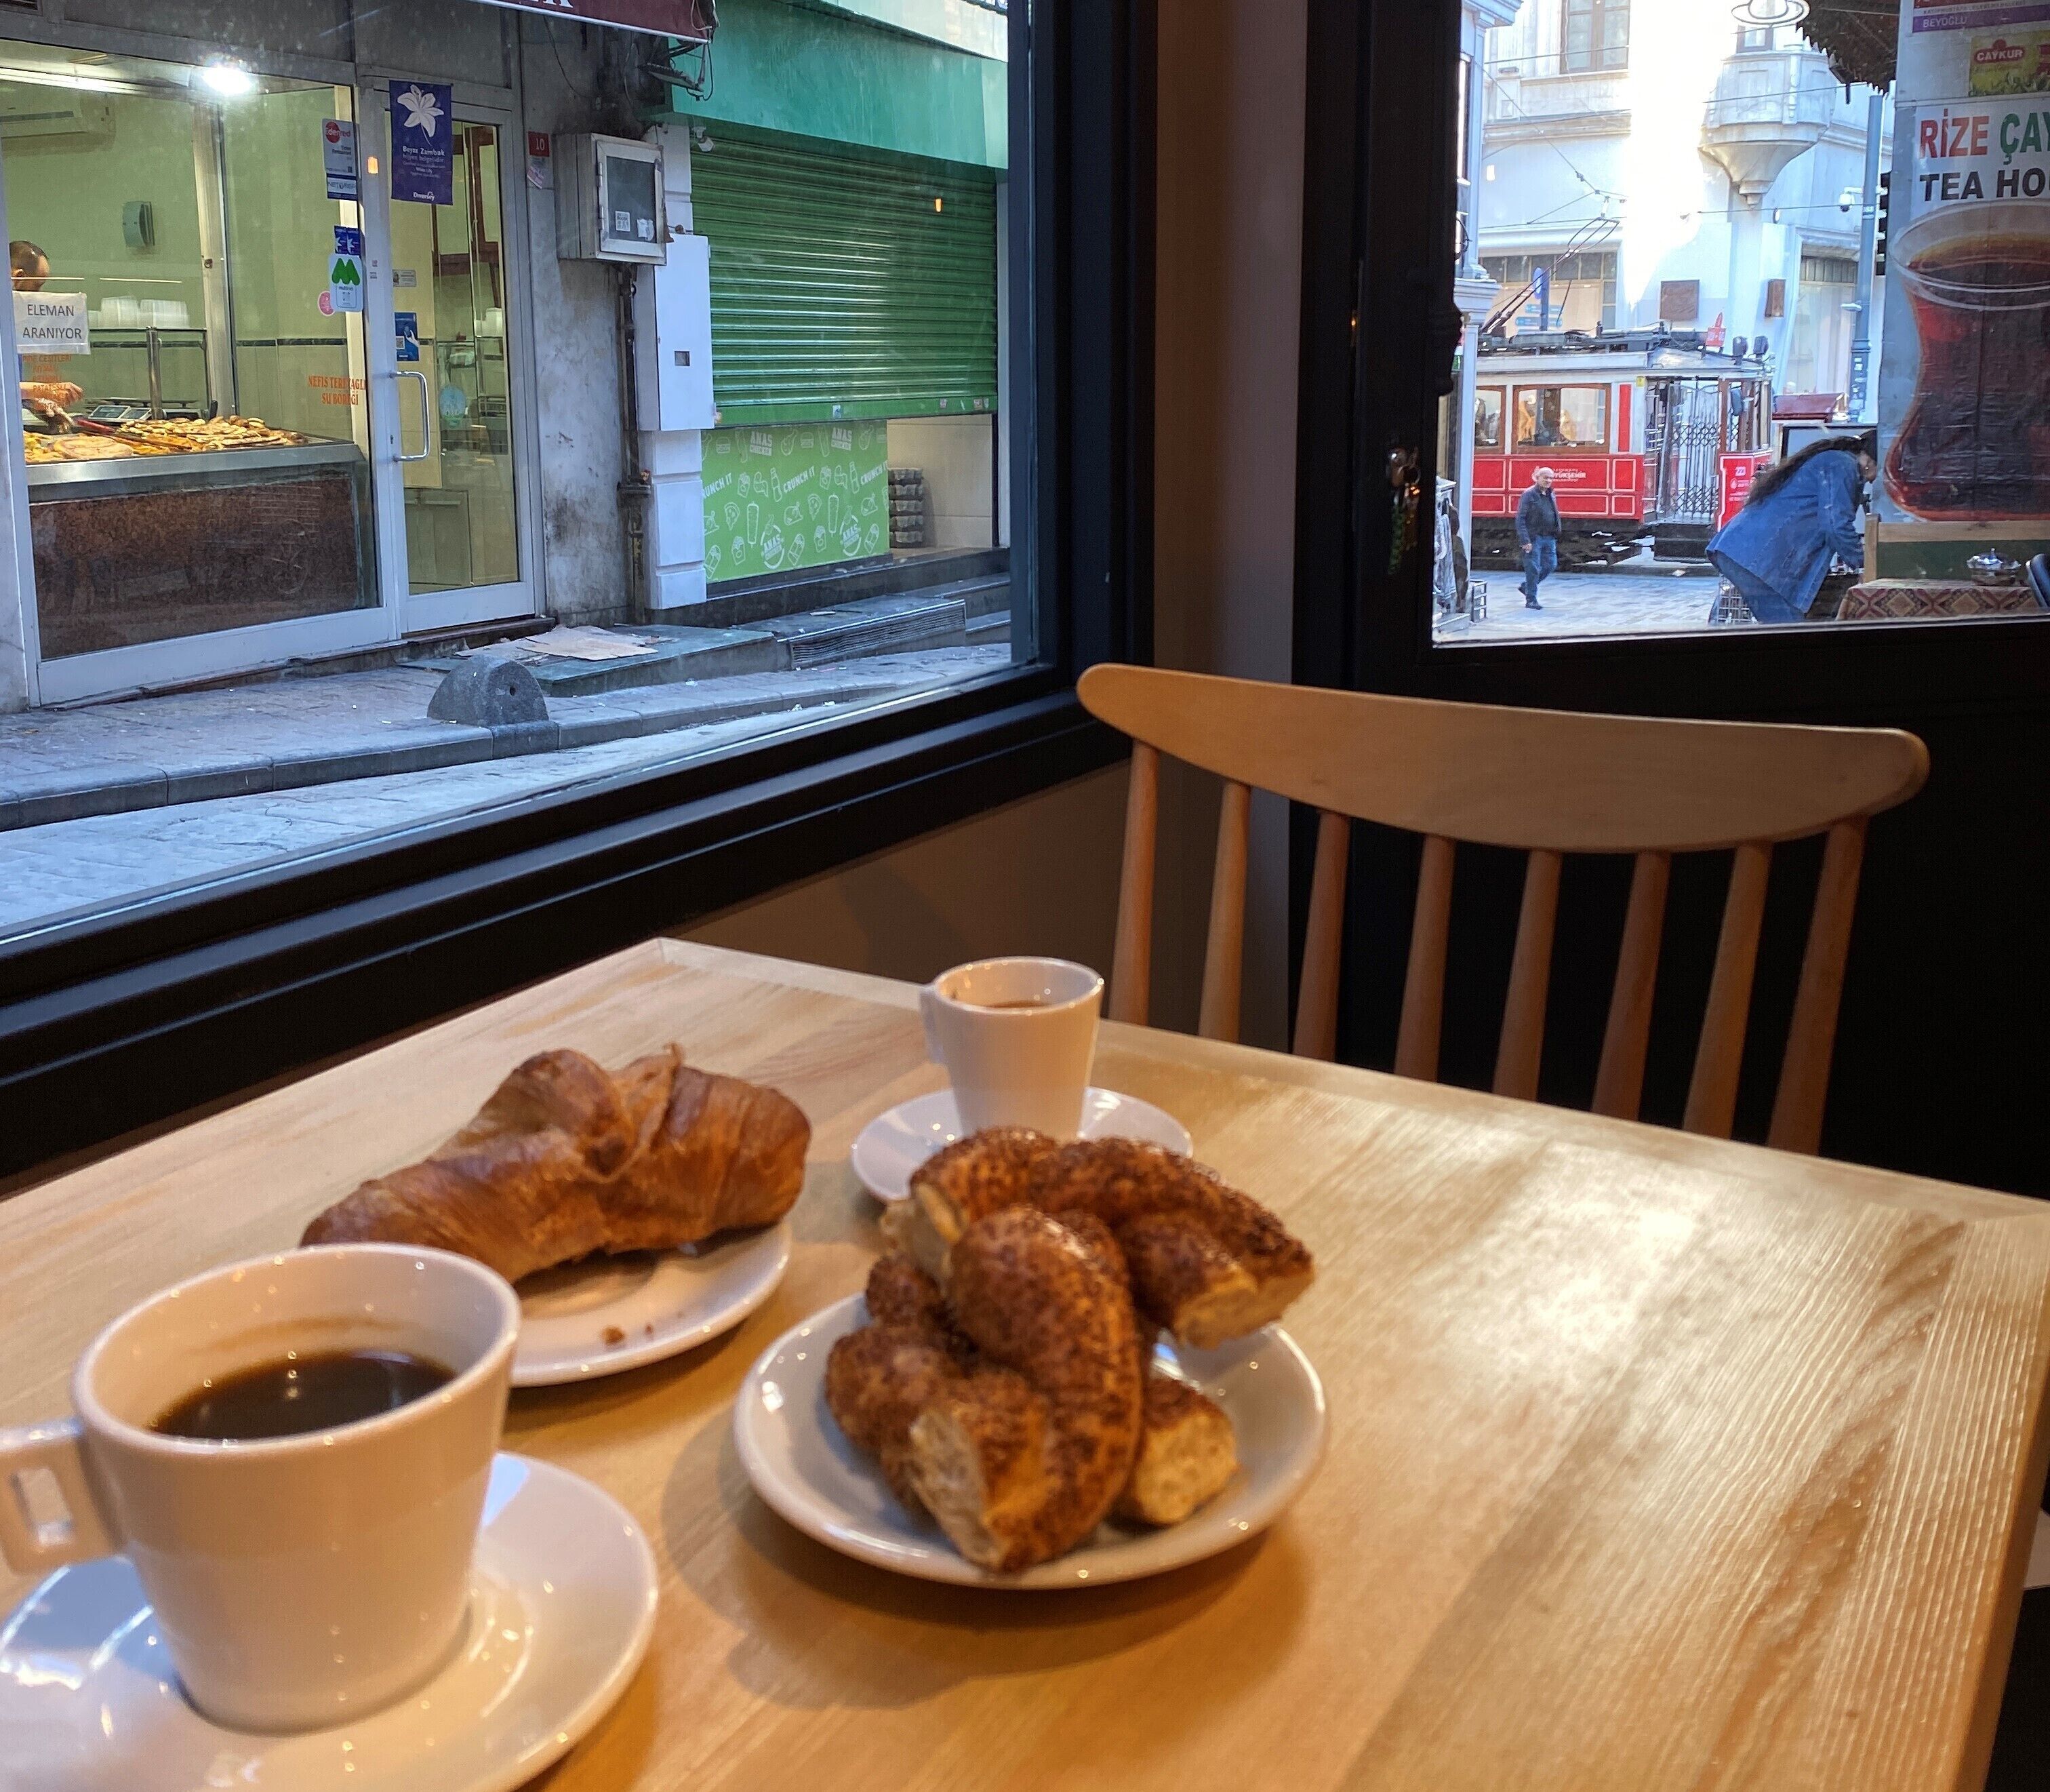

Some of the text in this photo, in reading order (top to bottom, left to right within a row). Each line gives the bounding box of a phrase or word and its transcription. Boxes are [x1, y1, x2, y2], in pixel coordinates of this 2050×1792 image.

[1923, 16, 1966, 28] BEYOĞLU
[1920, 108, 1990, 159] RİZE
[403, 145, 445, 157] Beyaz Zambak
[536, 138, 545, 151] 10
[1920, 167, 2050, 201] TEA HO
[27, 304, 74, 317] ELEMAN
[22, 327, 82, 339] ARANIYOR
[322, 393, 331, 405] SU
[725, 472, 732, 485] IT
[783, 466, 815, 493] CRUNCH IT
